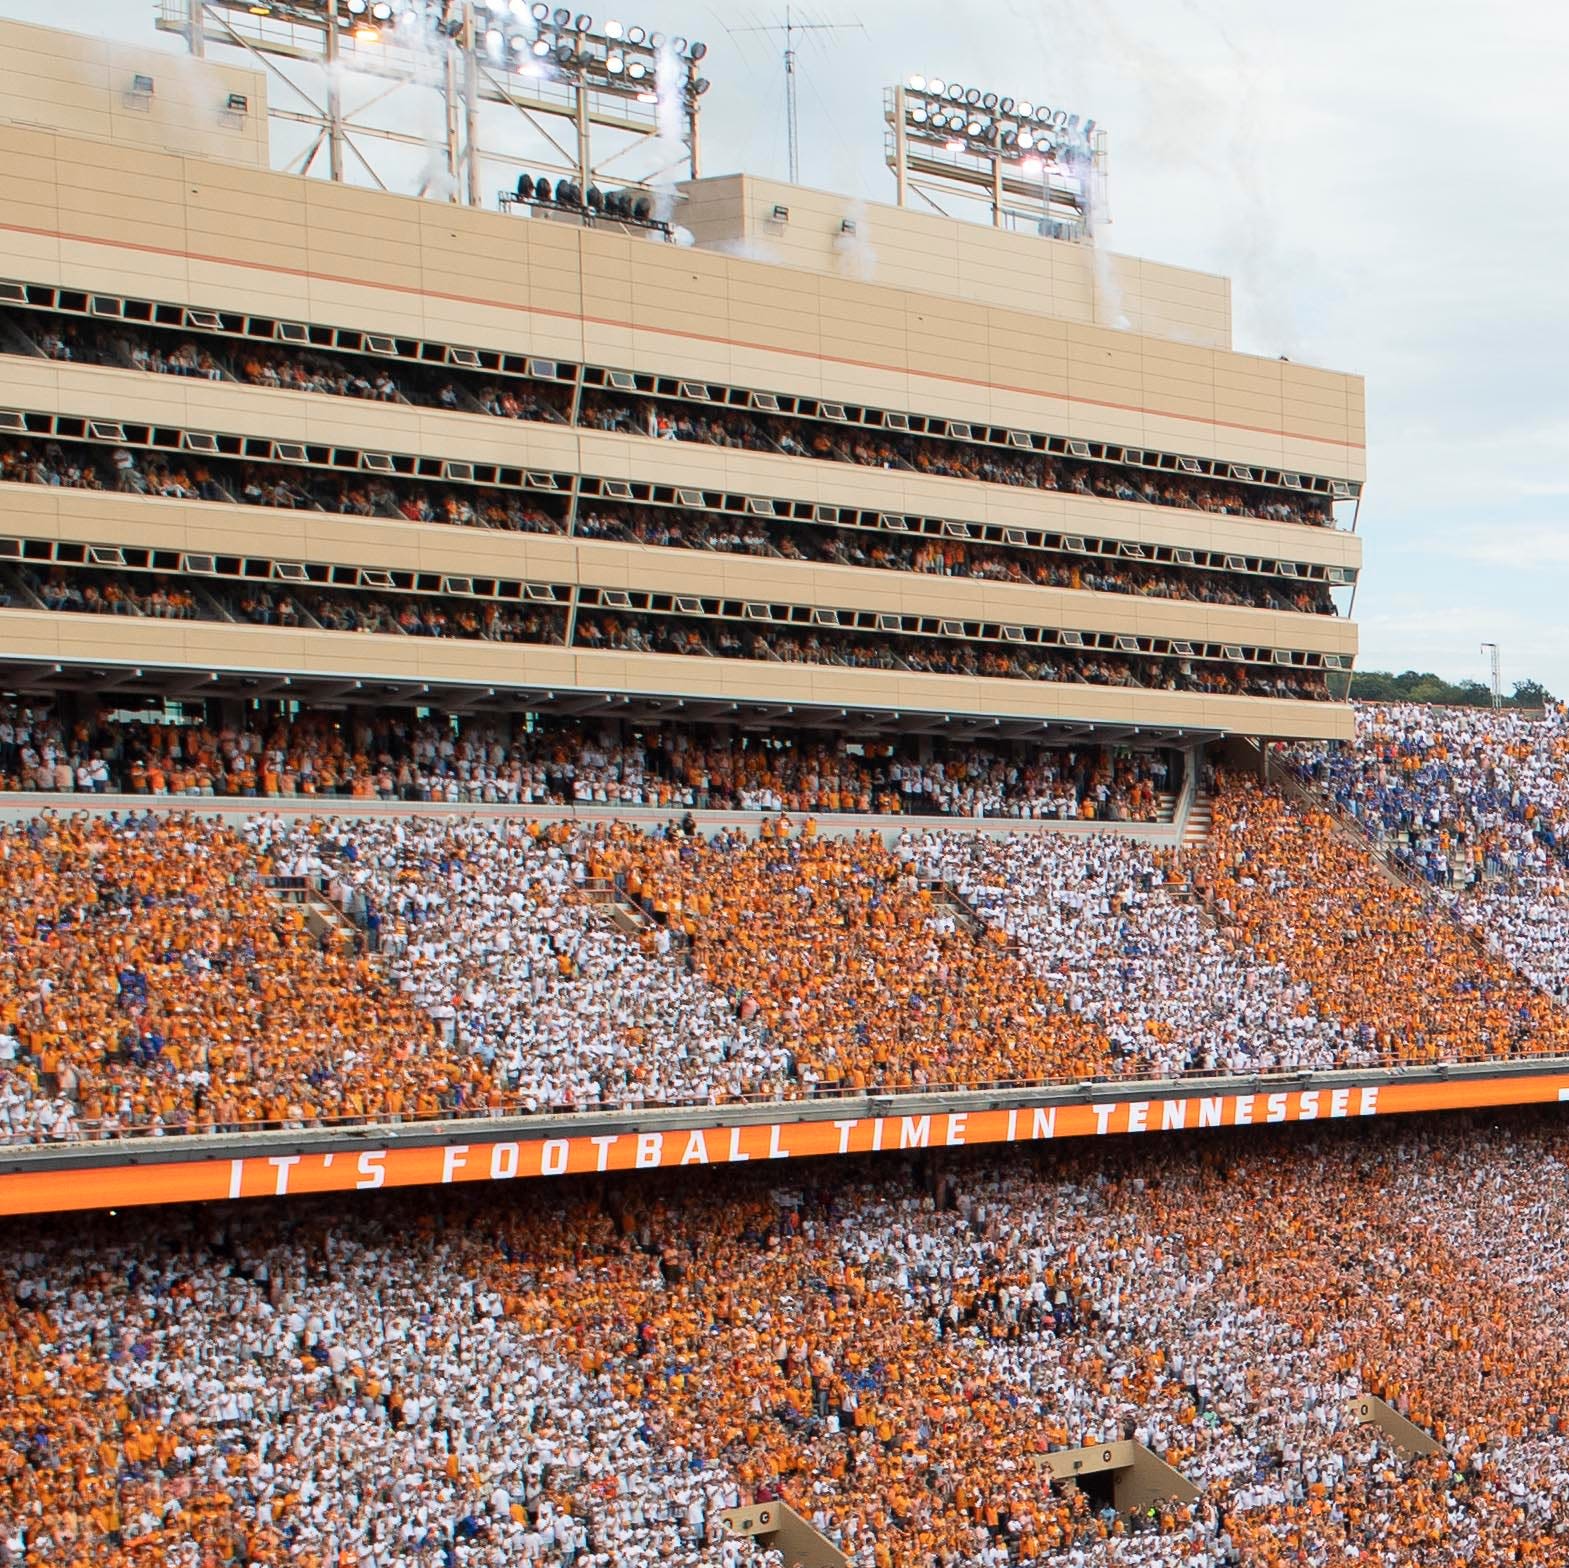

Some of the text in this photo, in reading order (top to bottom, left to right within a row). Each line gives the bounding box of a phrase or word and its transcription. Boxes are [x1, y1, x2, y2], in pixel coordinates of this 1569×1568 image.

[228, 1087, 1379, 1199] IT'S FOOTBALL TIME IN TENNESSEE
